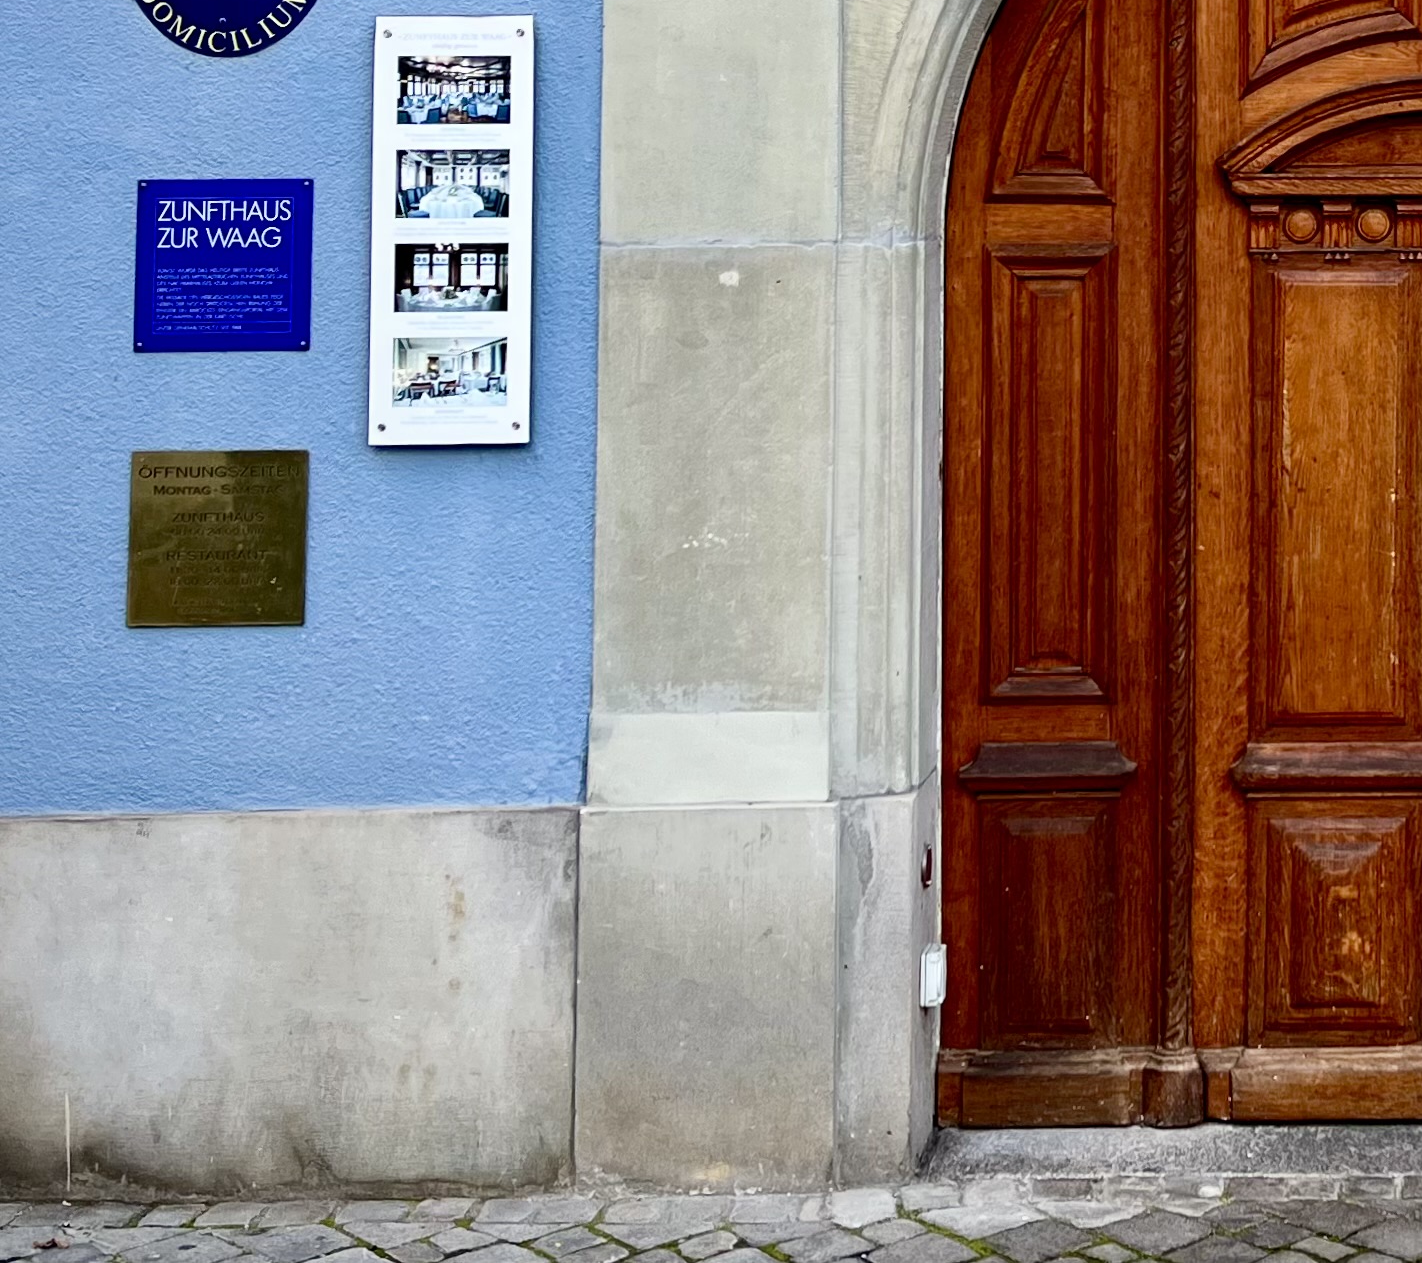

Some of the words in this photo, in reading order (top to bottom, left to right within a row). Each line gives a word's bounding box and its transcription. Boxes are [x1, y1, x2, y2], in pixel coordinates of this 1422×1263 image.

[158, 199, 292, 222] ZUNFTHAUS
[157, 227, 198, 248] ZUR
[206, 226, 282, 248] WAAG
[138, 465, 299, 479] ÖFFNUNGSZEITEN
[153, 485, 211, 496] MONTAG
[172, 511, 265, 523] ZUNFTHAUS
[166, 550, 269, 562] RESTAURANT
